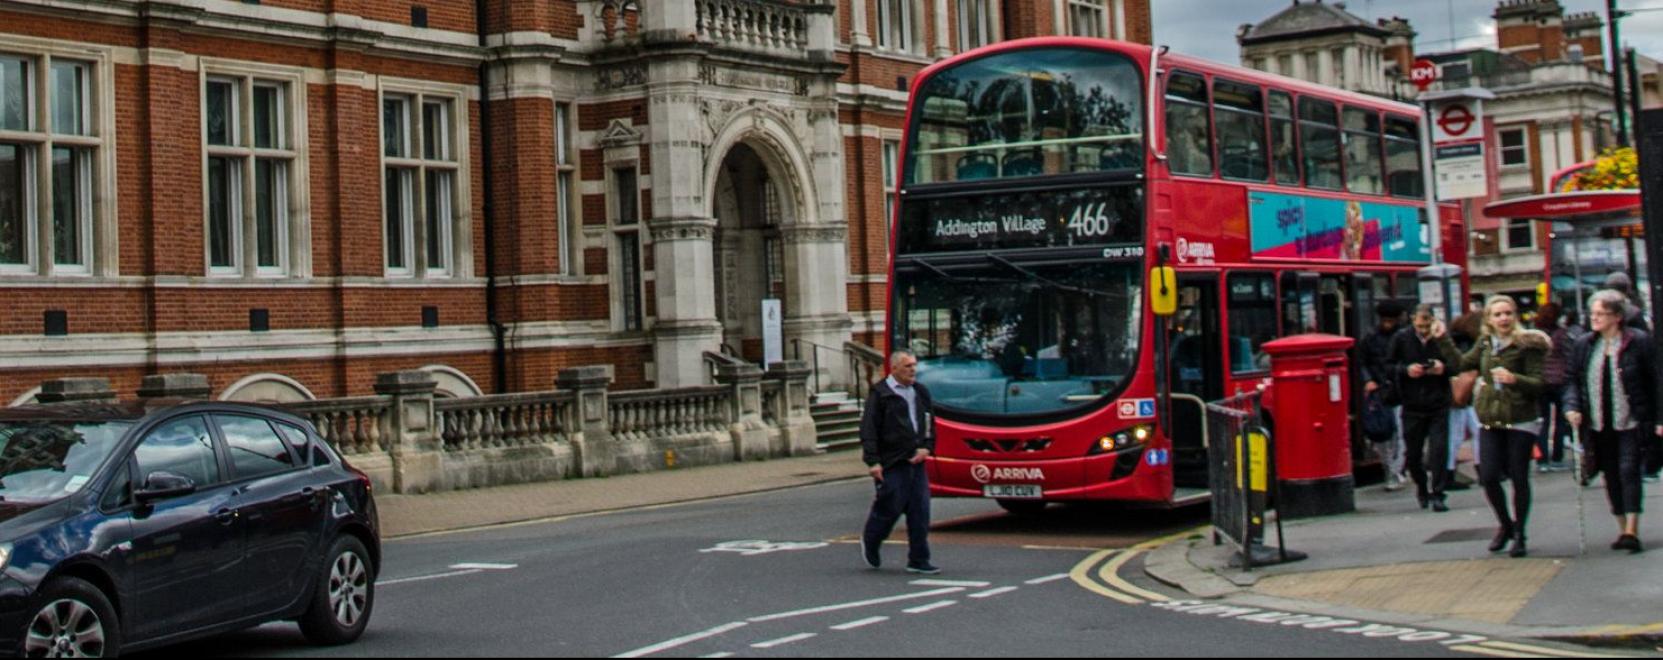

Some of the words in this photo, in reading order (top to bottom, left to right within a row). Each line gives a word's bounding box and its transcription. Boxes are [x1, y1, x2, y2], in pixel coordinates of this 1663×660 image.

[1411, 67, 1434, 81] KM
[935, 219, 997, 238] Addington
[1001, 215, 1046, 234] Village
[1068, 202, 1109, 236] 466
[993, 466, 1045, 480] ARRIVA
[1331, 622, 1488, 645] LOOK
